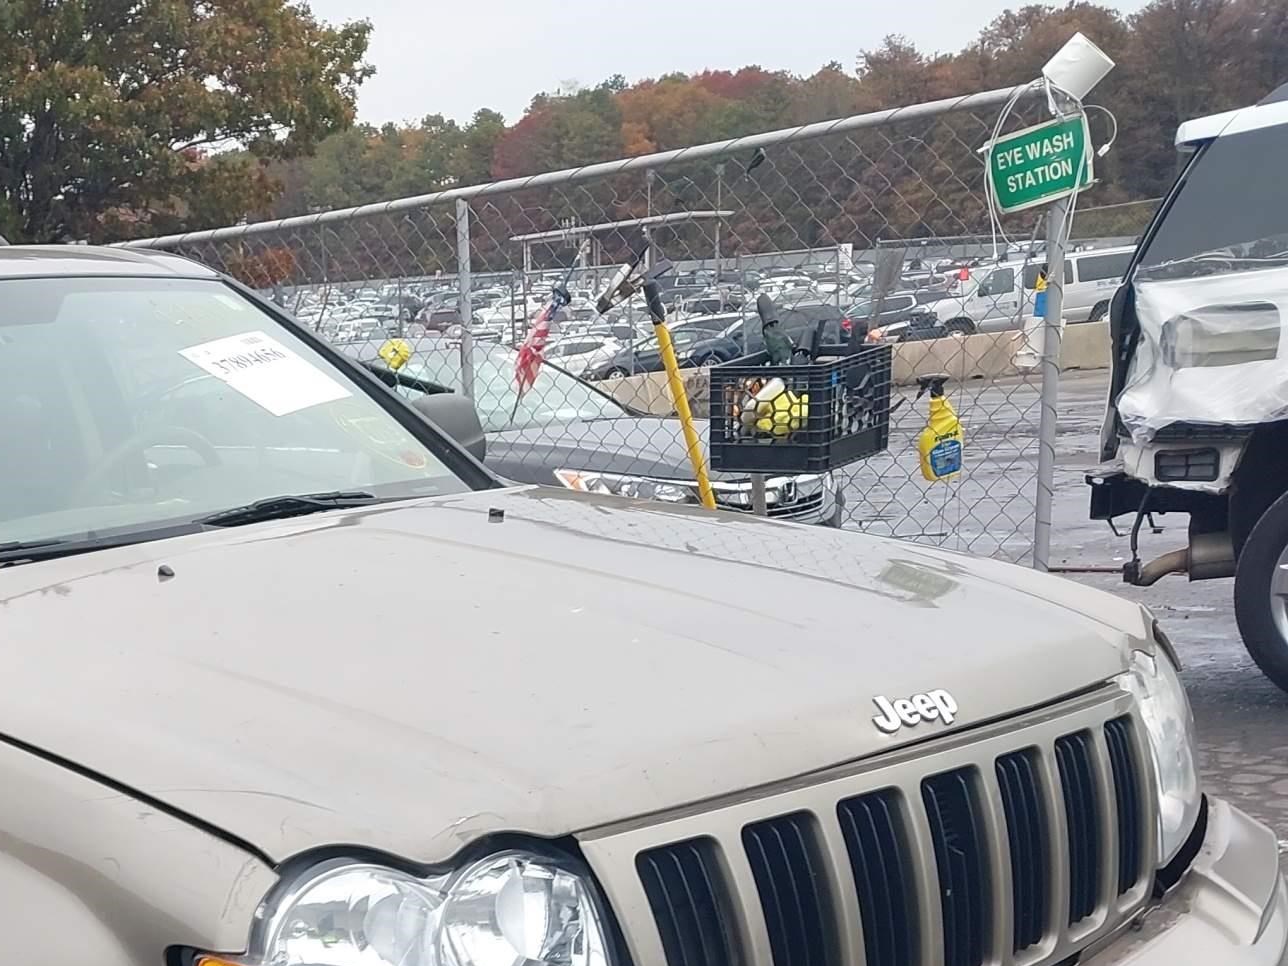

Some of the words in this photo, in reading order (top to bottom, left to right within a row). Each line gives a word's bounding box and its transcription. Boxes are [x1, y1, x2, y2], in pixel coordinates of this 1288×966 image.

[996, 146, 1025, 171] EYE
[1025, 131, 1074, 161] WASH
[1007, 158, 1073, 193] STATION
[872, 688, 958, 734] Jeep
